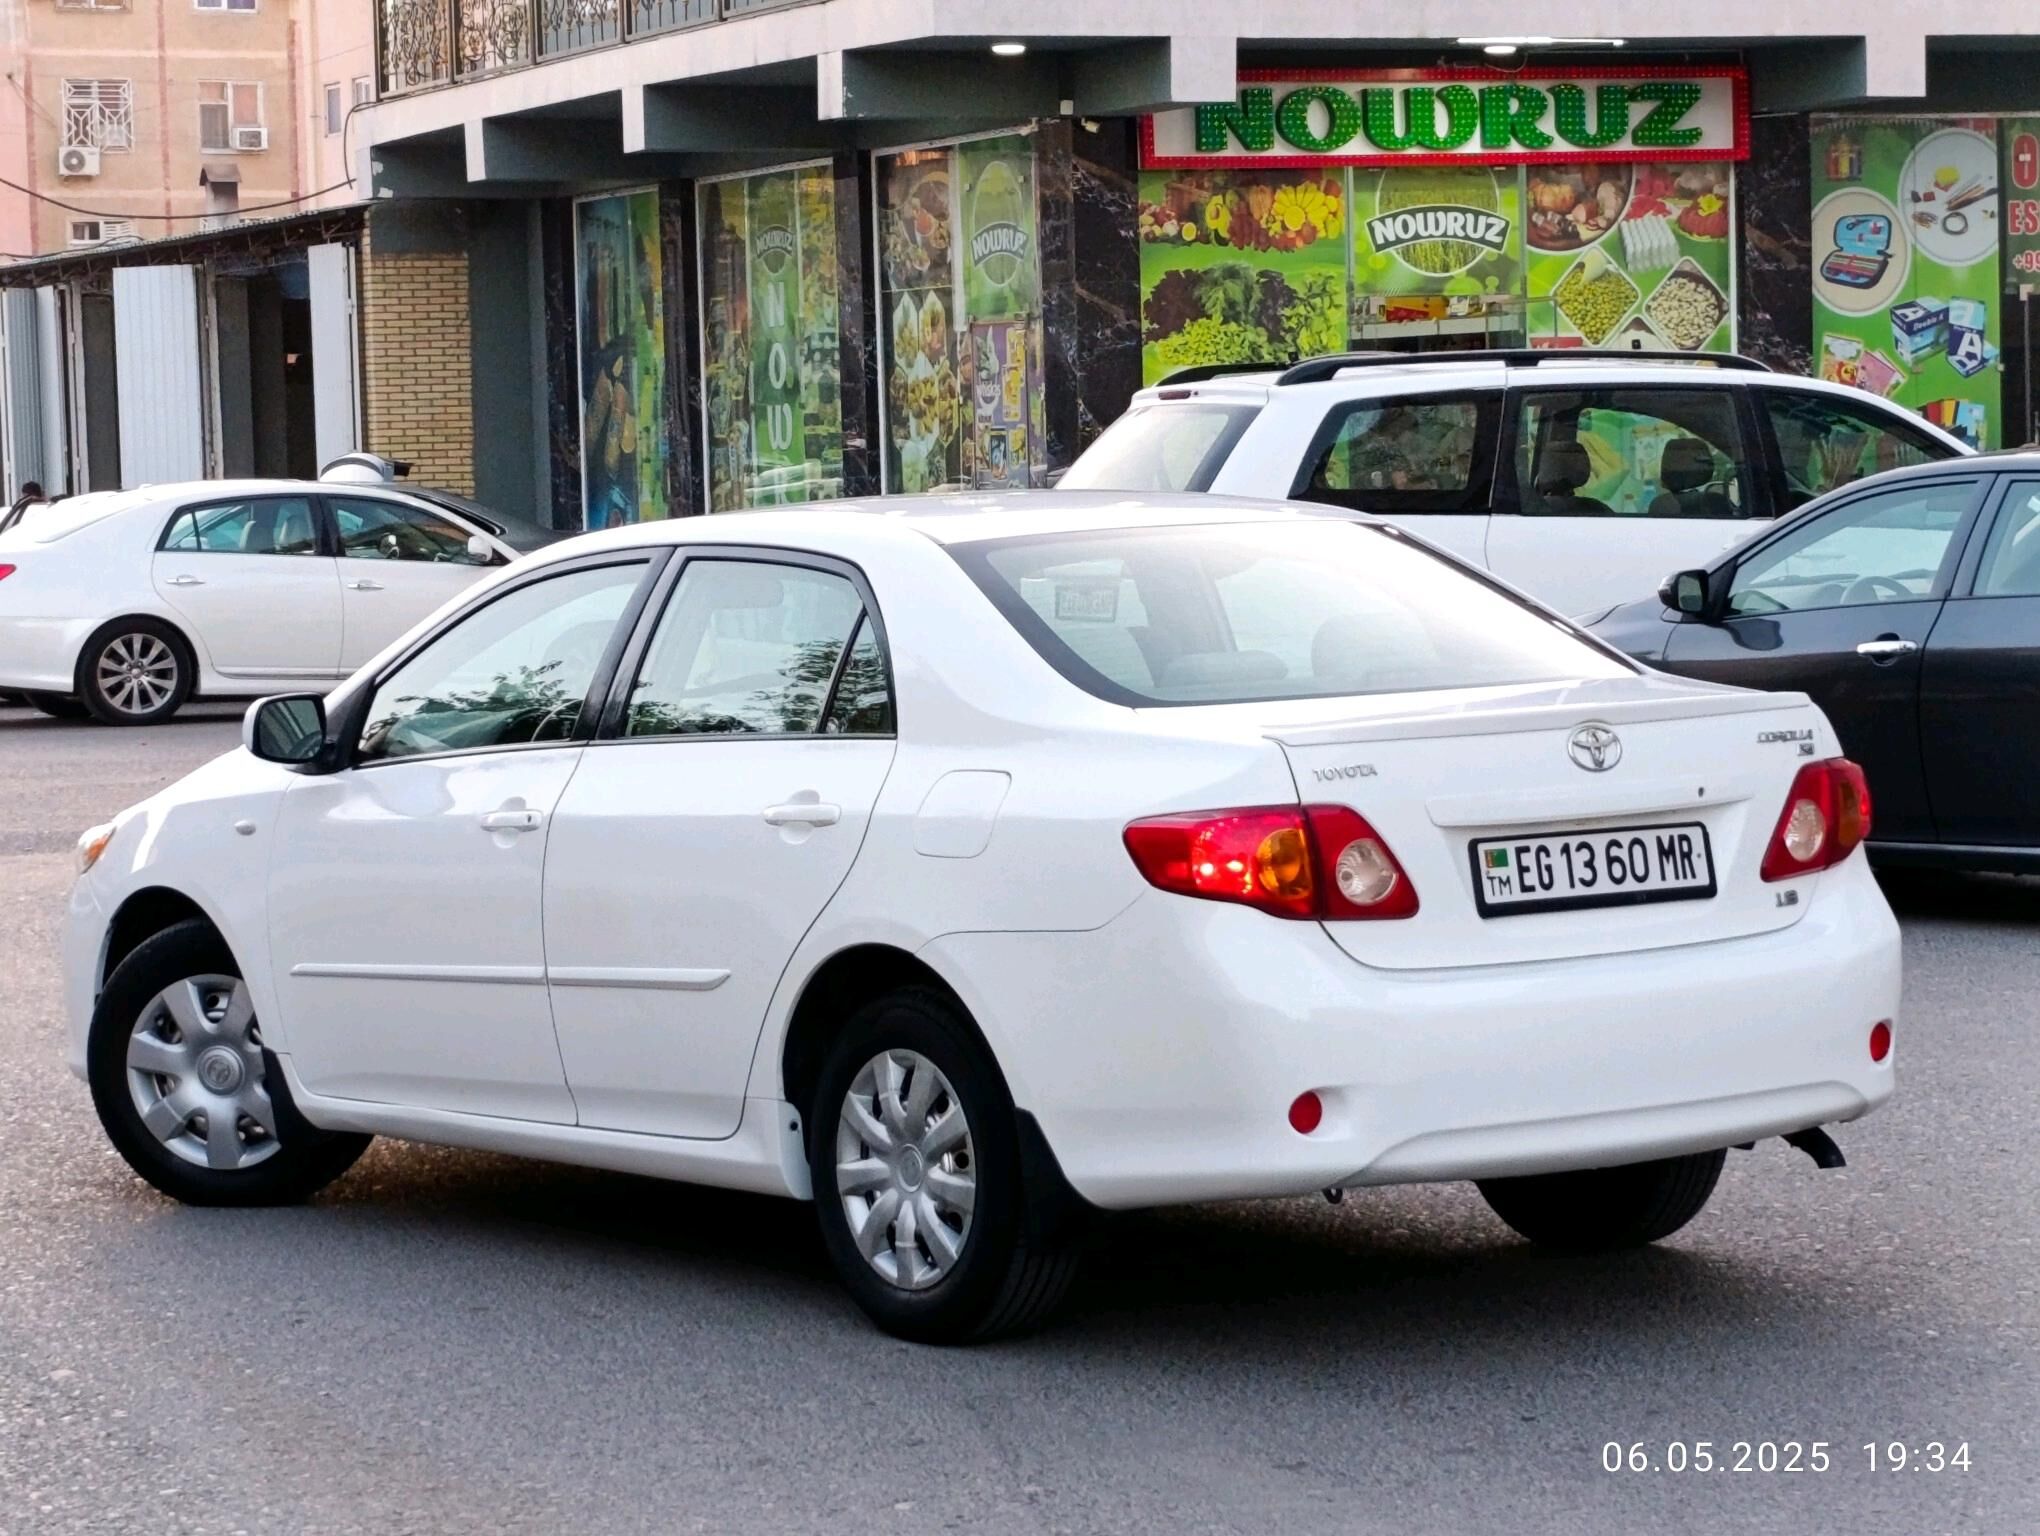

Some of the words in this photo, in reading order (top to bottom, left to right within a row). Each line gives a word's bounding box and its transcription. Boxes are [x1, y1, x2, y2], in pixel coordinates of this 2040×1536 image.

[1195, 83, 1703, 152] NOWRUZ
[1371, 211, 1506, 245] NOWRUZ
[1956, 332, 1983, 362] A
[1312, 763, 1378, 782] TOYOTA
[1487, 874, 1512, 897] TM
